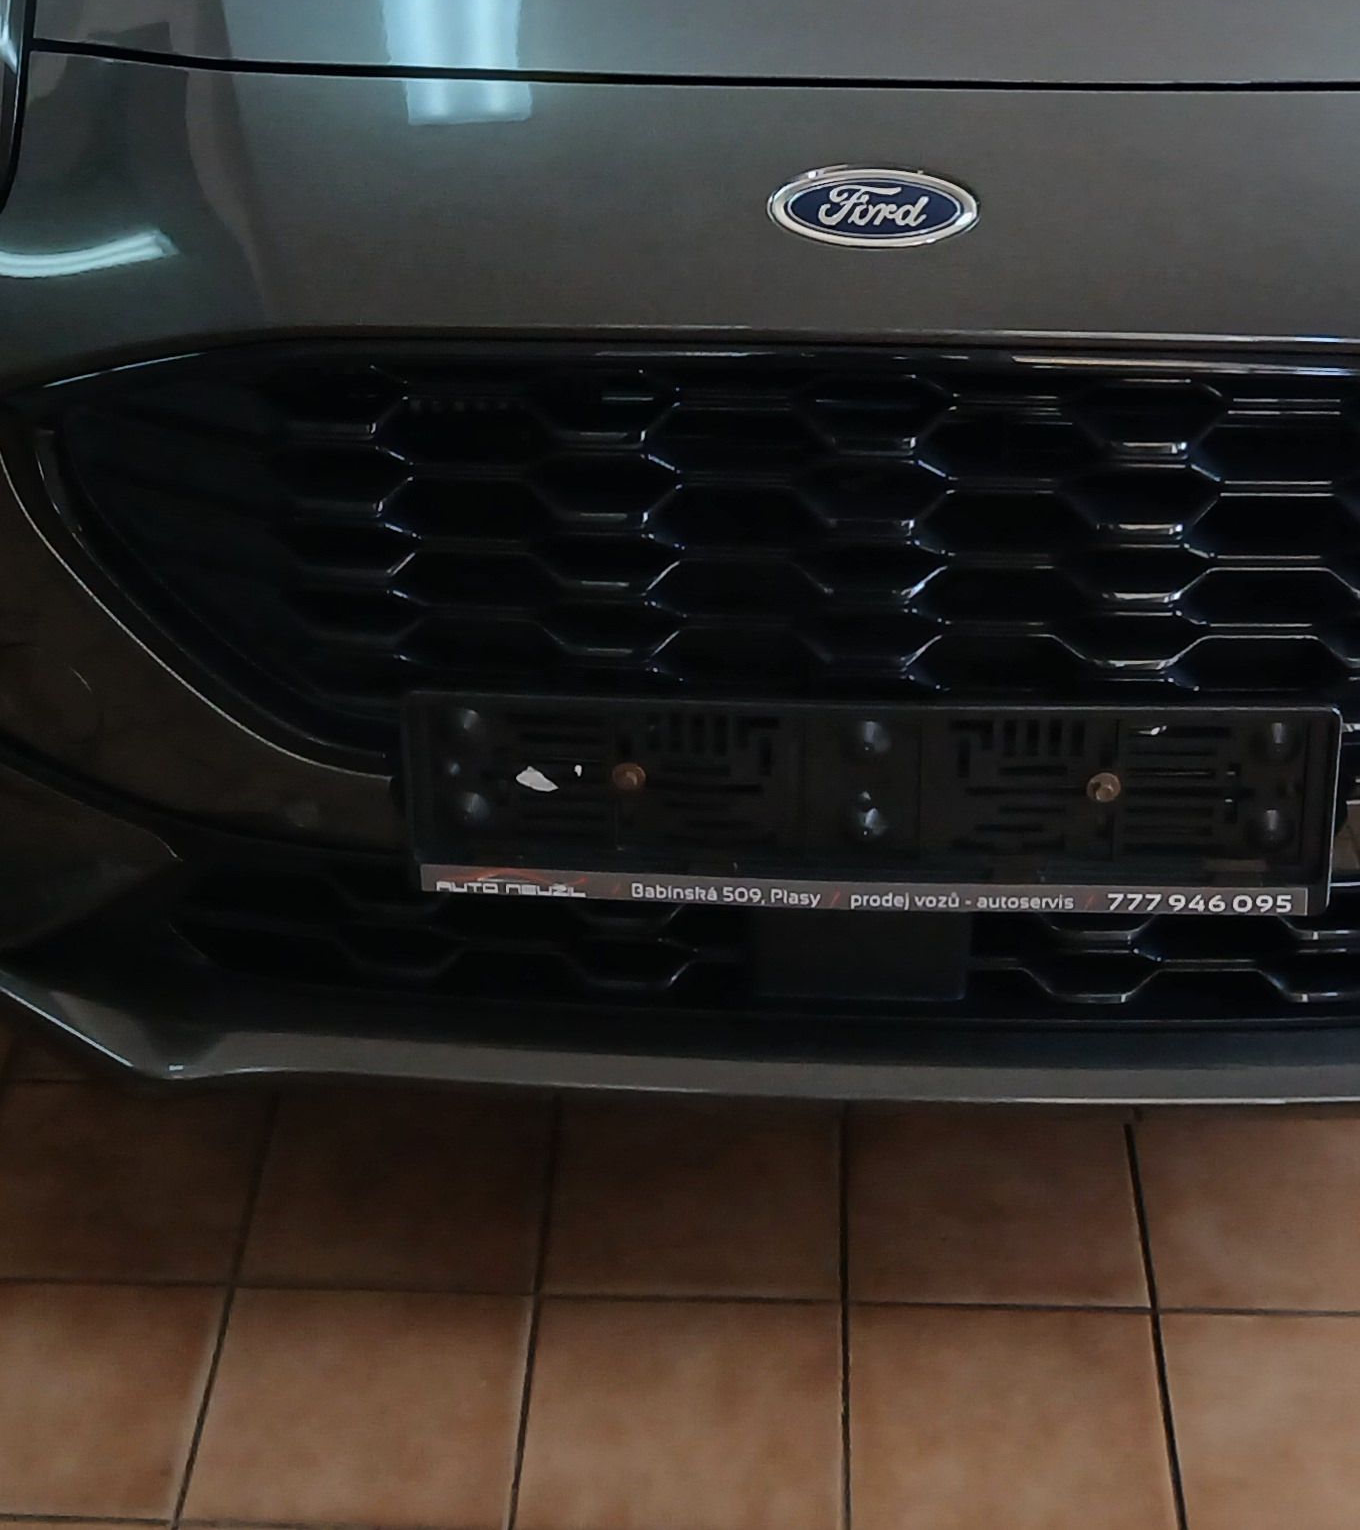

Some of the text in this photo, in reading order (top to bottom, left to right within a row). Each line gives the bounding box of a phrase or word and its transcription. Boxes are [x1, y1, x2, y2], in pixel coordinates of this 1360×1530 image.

[817, 183, 930, 228] Ford
[436, 880, 499, 895] AUTO
[722, 886, 766, 906] 509,
[770, 888, 821, 908] Plasy
[850, 891, 910, 911] prodej
[914, 891, 960, 909] vozů
[976, 894, 1074, 910] autoservis
[1107, 893, 1163, 911] 777
[1167, 894, 1226, 912] 946
[1232, 894, 1292, 913] 095
